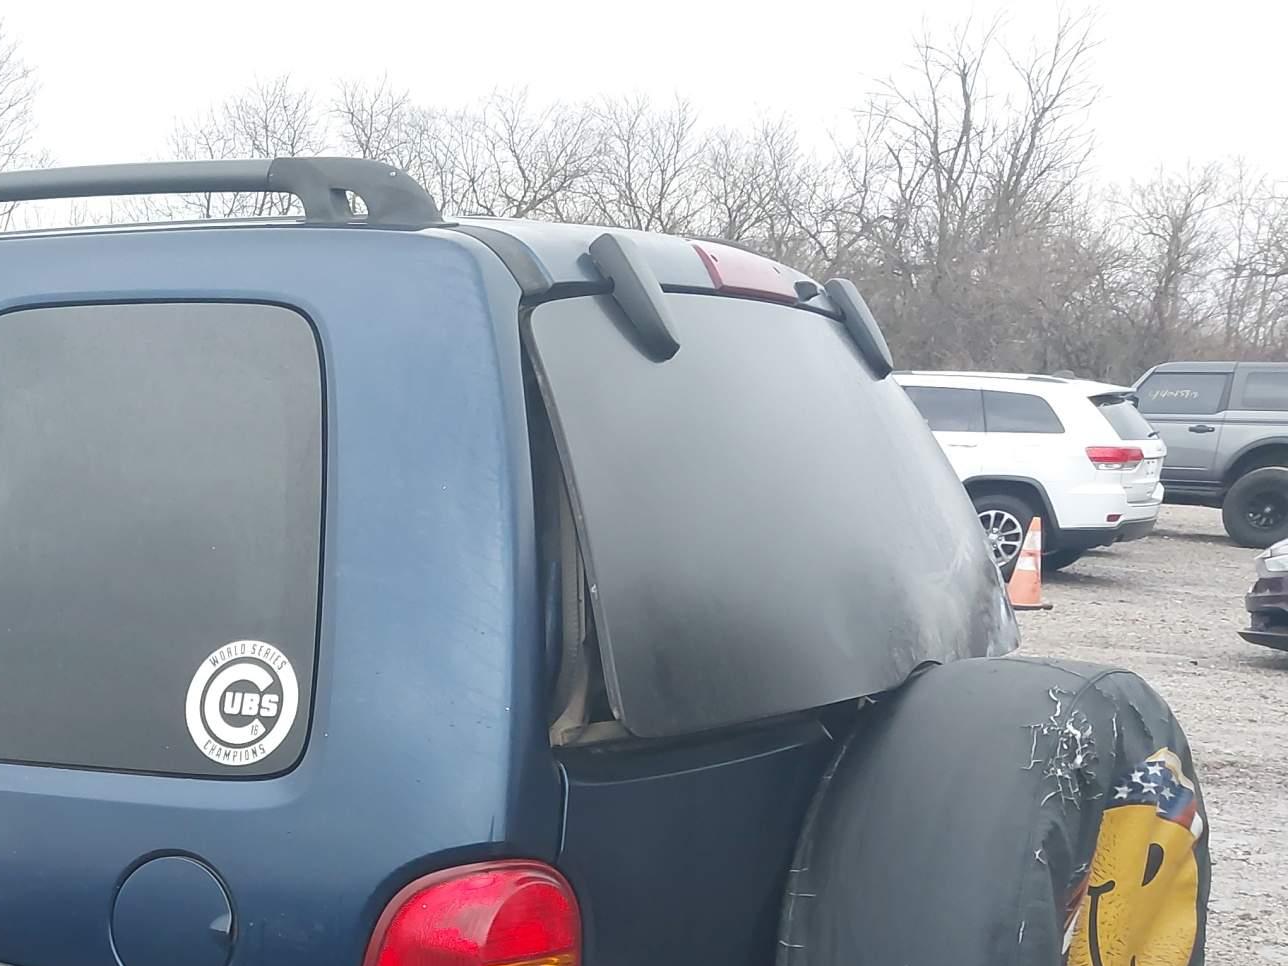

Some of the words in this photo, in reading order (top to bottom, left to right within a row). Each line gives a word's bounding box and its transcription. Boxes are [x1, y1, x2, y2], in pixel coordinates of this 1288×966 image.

[208, 643, 246, 667] WORLD
[250, 643, 287, 671] SERIES
[203, 738, 266, 762] CHAMPIONS
